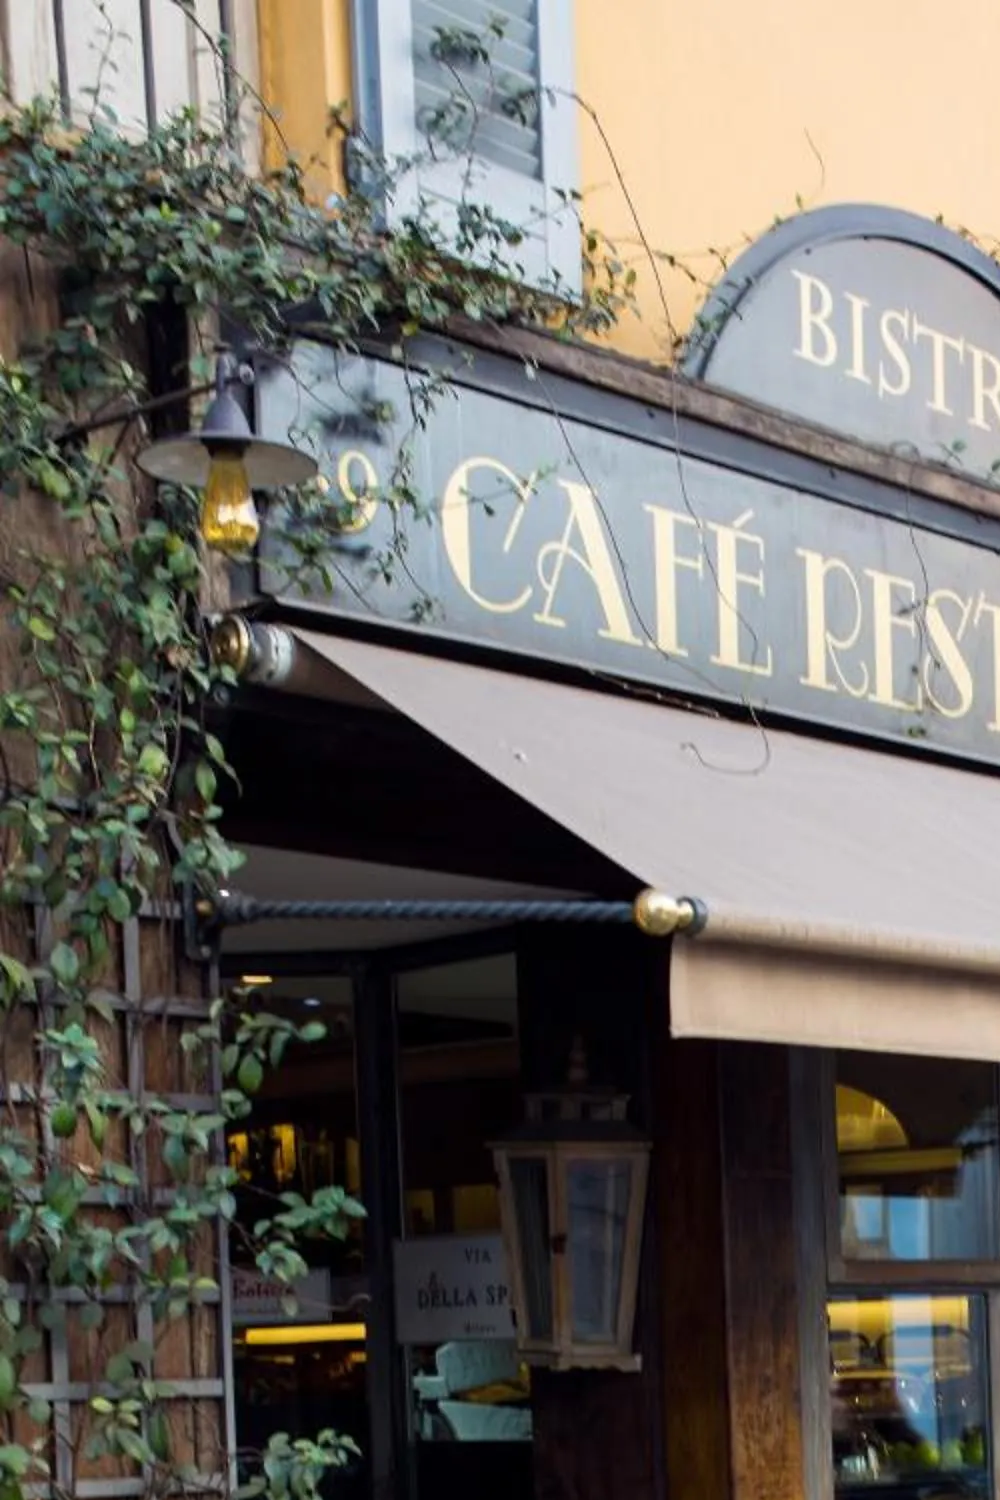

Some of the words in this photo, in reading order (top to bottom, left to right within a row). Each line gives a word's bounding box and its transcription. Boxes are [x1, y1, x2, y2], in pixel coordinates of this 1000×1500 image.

[441, 456, 773, 676] CAFÉ
[465, 1247, 492, 1264] VIA
[418, 1285, 478, 1311] DELLA
